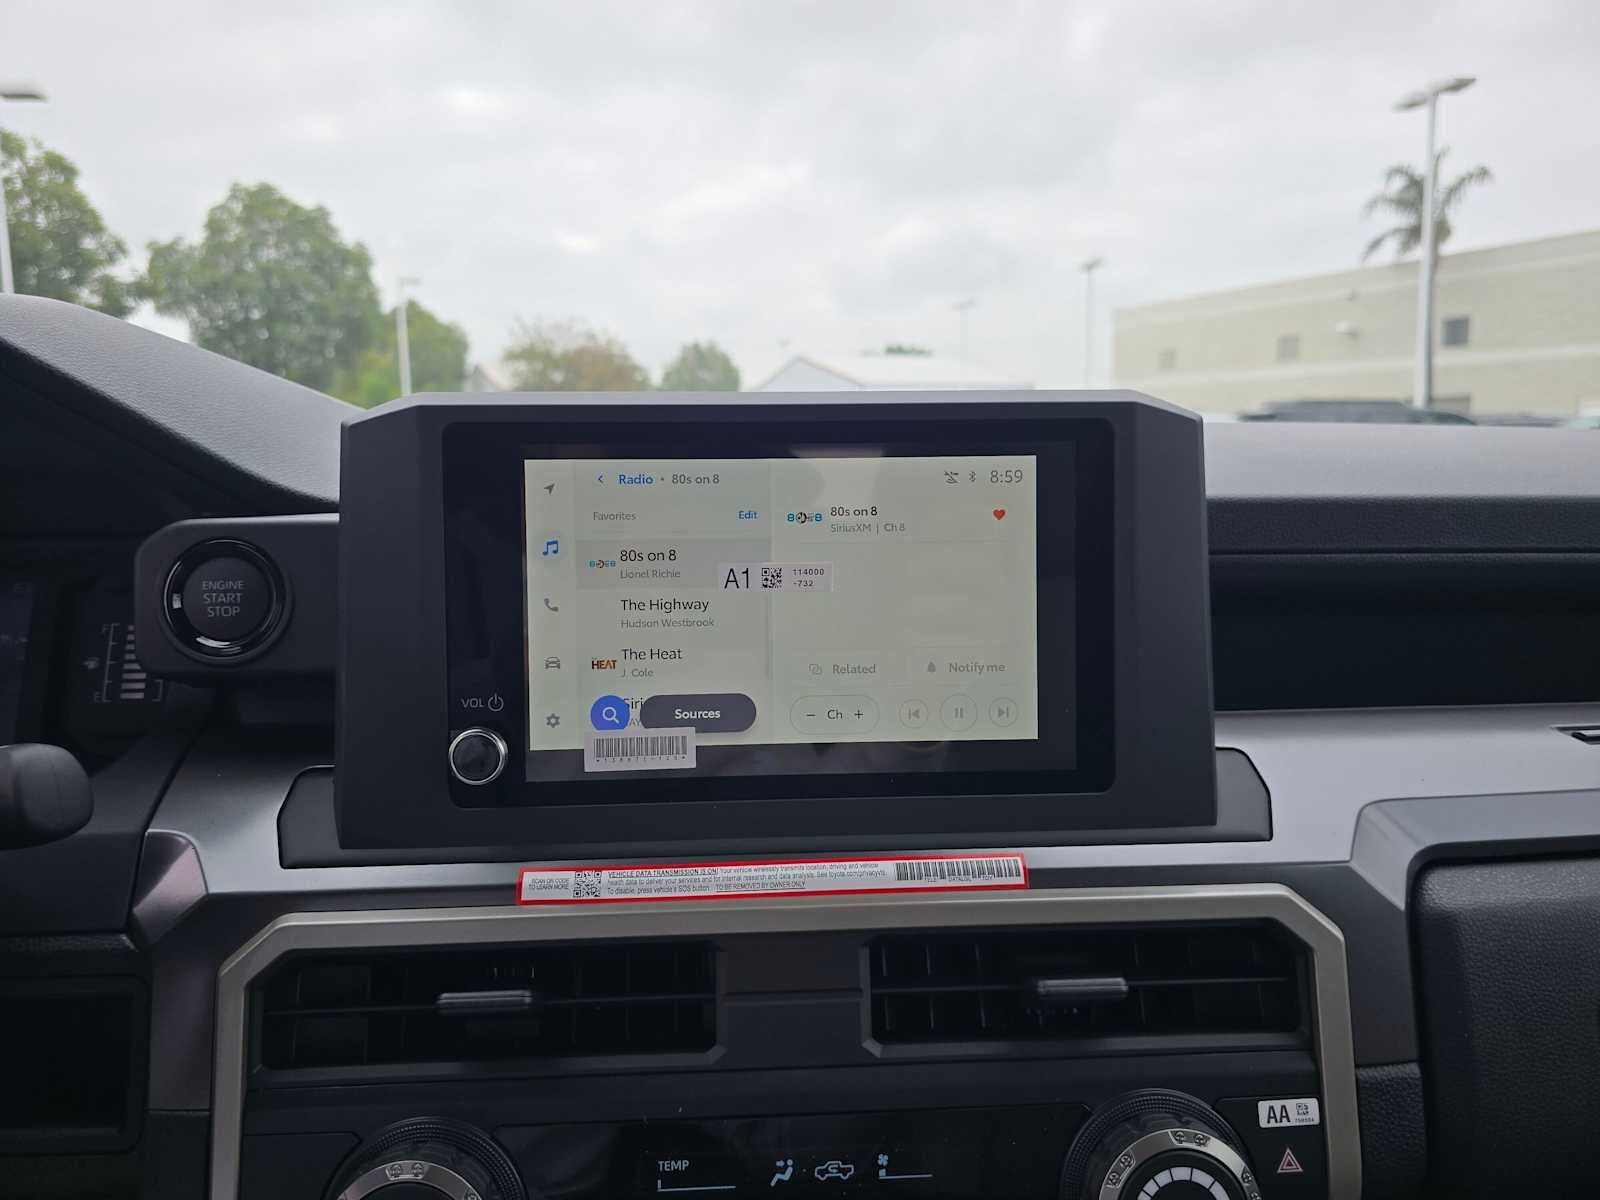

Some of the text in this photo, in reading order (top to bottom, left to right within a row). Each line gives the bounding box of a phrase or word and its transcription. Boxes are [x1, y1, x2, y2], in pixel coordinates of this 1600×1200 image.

[618, 473, 720, 485] Radio 80s on 8
[989, 470, 1023, 484] 8:59
[593, 511, 637, 521] Favorites
[738, 510, 758, 520] Edit
[830, 505, 878, 517] 80s on 8
[831, 523, 872, 533] SiriusXM
[620, 549, 677, 562] 80s on 8
[620, 567, 681, 579] Lionel Richie
[792, 568, 825, 576] 114000
[724, 567, 752, 589] A1
[793, 579, 814, 587] -732
[202, 580, 244, 590] ENGINE
[202, 592, 243, 604] START
[207, 606, 240, 617] STOP
[621, 599, 709, 613] The Highway
[621, 617, 714, 628] Hudson Westbrook
[622, 648, 683, 660] The Heat
[592, 660, 617, 669] HEAT
[832, 664, 876, 674] Related
[949, 661, 1006, 674] Notify me
[631, 668, 654, 677] Cole
[461, 698, 485, 708] VOL
[674, 708, 721, 719] Sources
[827, 709, 843, 720] Ch
[608, 871, 634, 879] VEHICLE
[636, 870, 652, 878] DATA
[653, 868, 699, 877] TRANSMISSION
[1266, 1104, 1291, 1124] AA
[658, 1160, 689, 1171] TEMP
